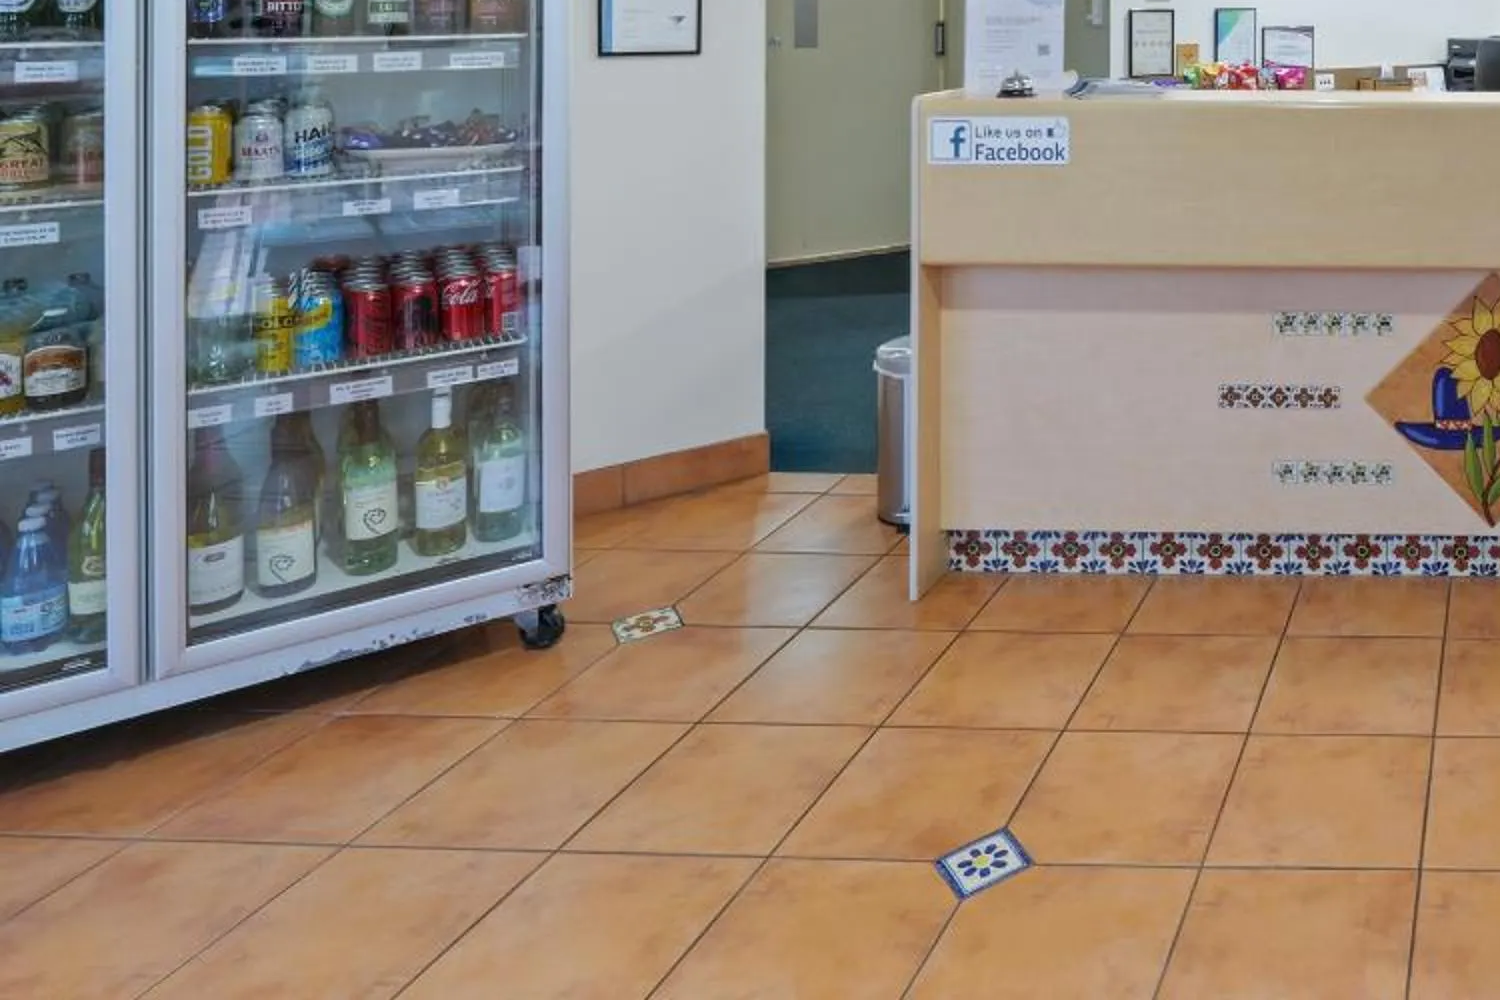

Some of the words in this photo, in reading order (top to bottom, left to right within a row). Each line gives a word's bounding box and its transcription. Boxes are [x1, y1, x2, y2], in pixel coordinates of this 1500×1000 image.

[975, 125, 1001, 139] Like
[1005, 128, 1021, 139] us
[1025, 128, 1043, 139] on
[974, 142, 1066, 162] Facebook
